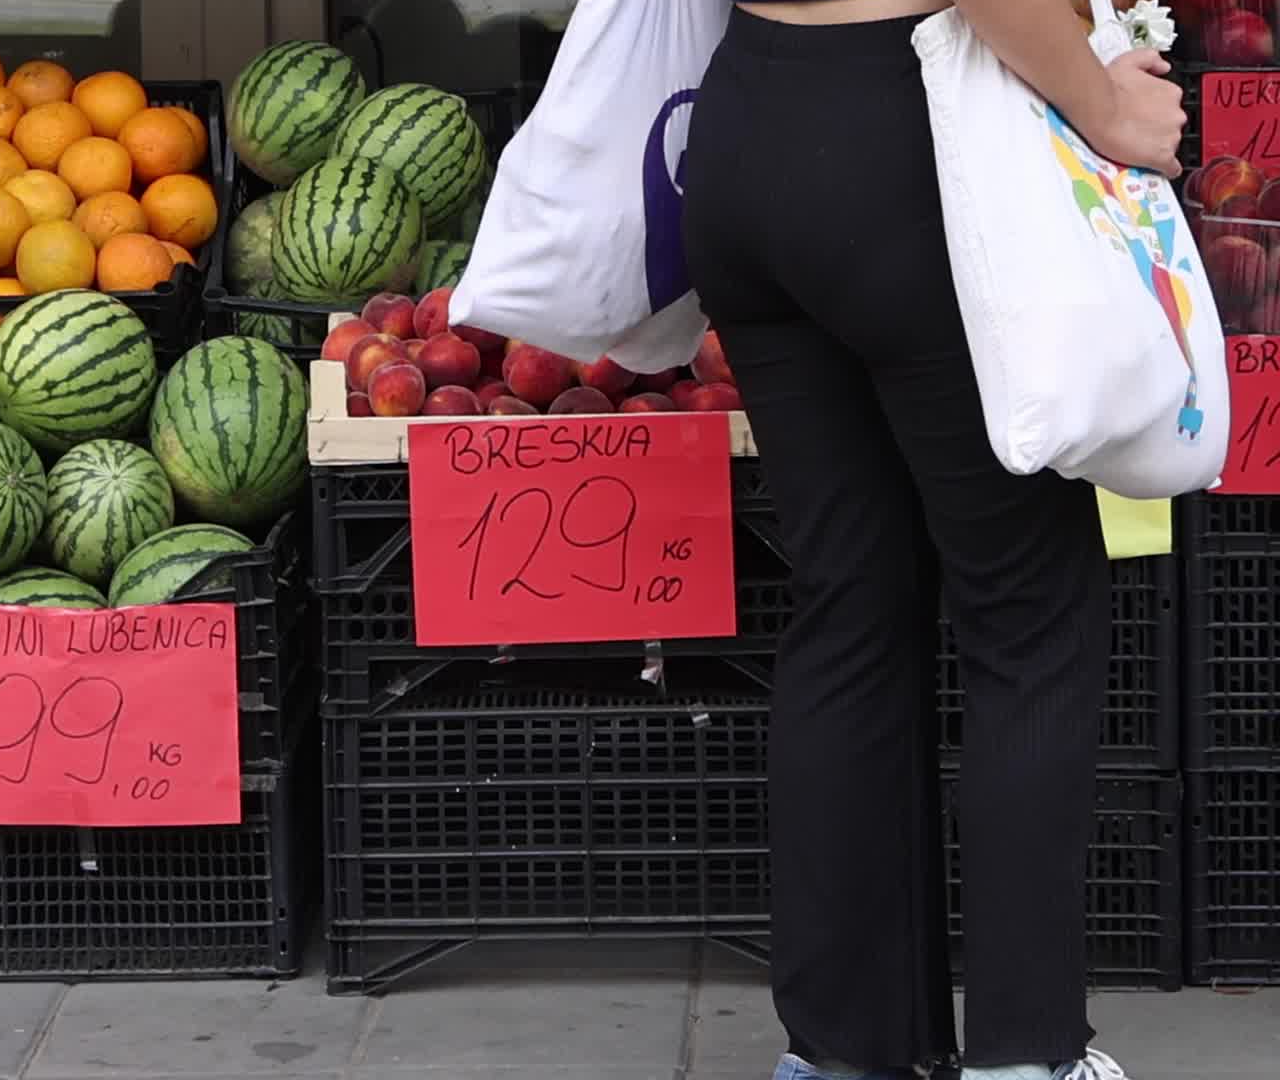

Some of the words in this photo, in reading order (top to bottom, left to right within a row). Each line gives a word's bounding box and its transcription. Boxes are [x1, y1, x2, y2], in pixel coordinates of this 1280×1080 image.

[661, 537, 693, 561] KG
[66, 611, 228, 655] LUBENICA
[149, 742, 183, 767] KG
